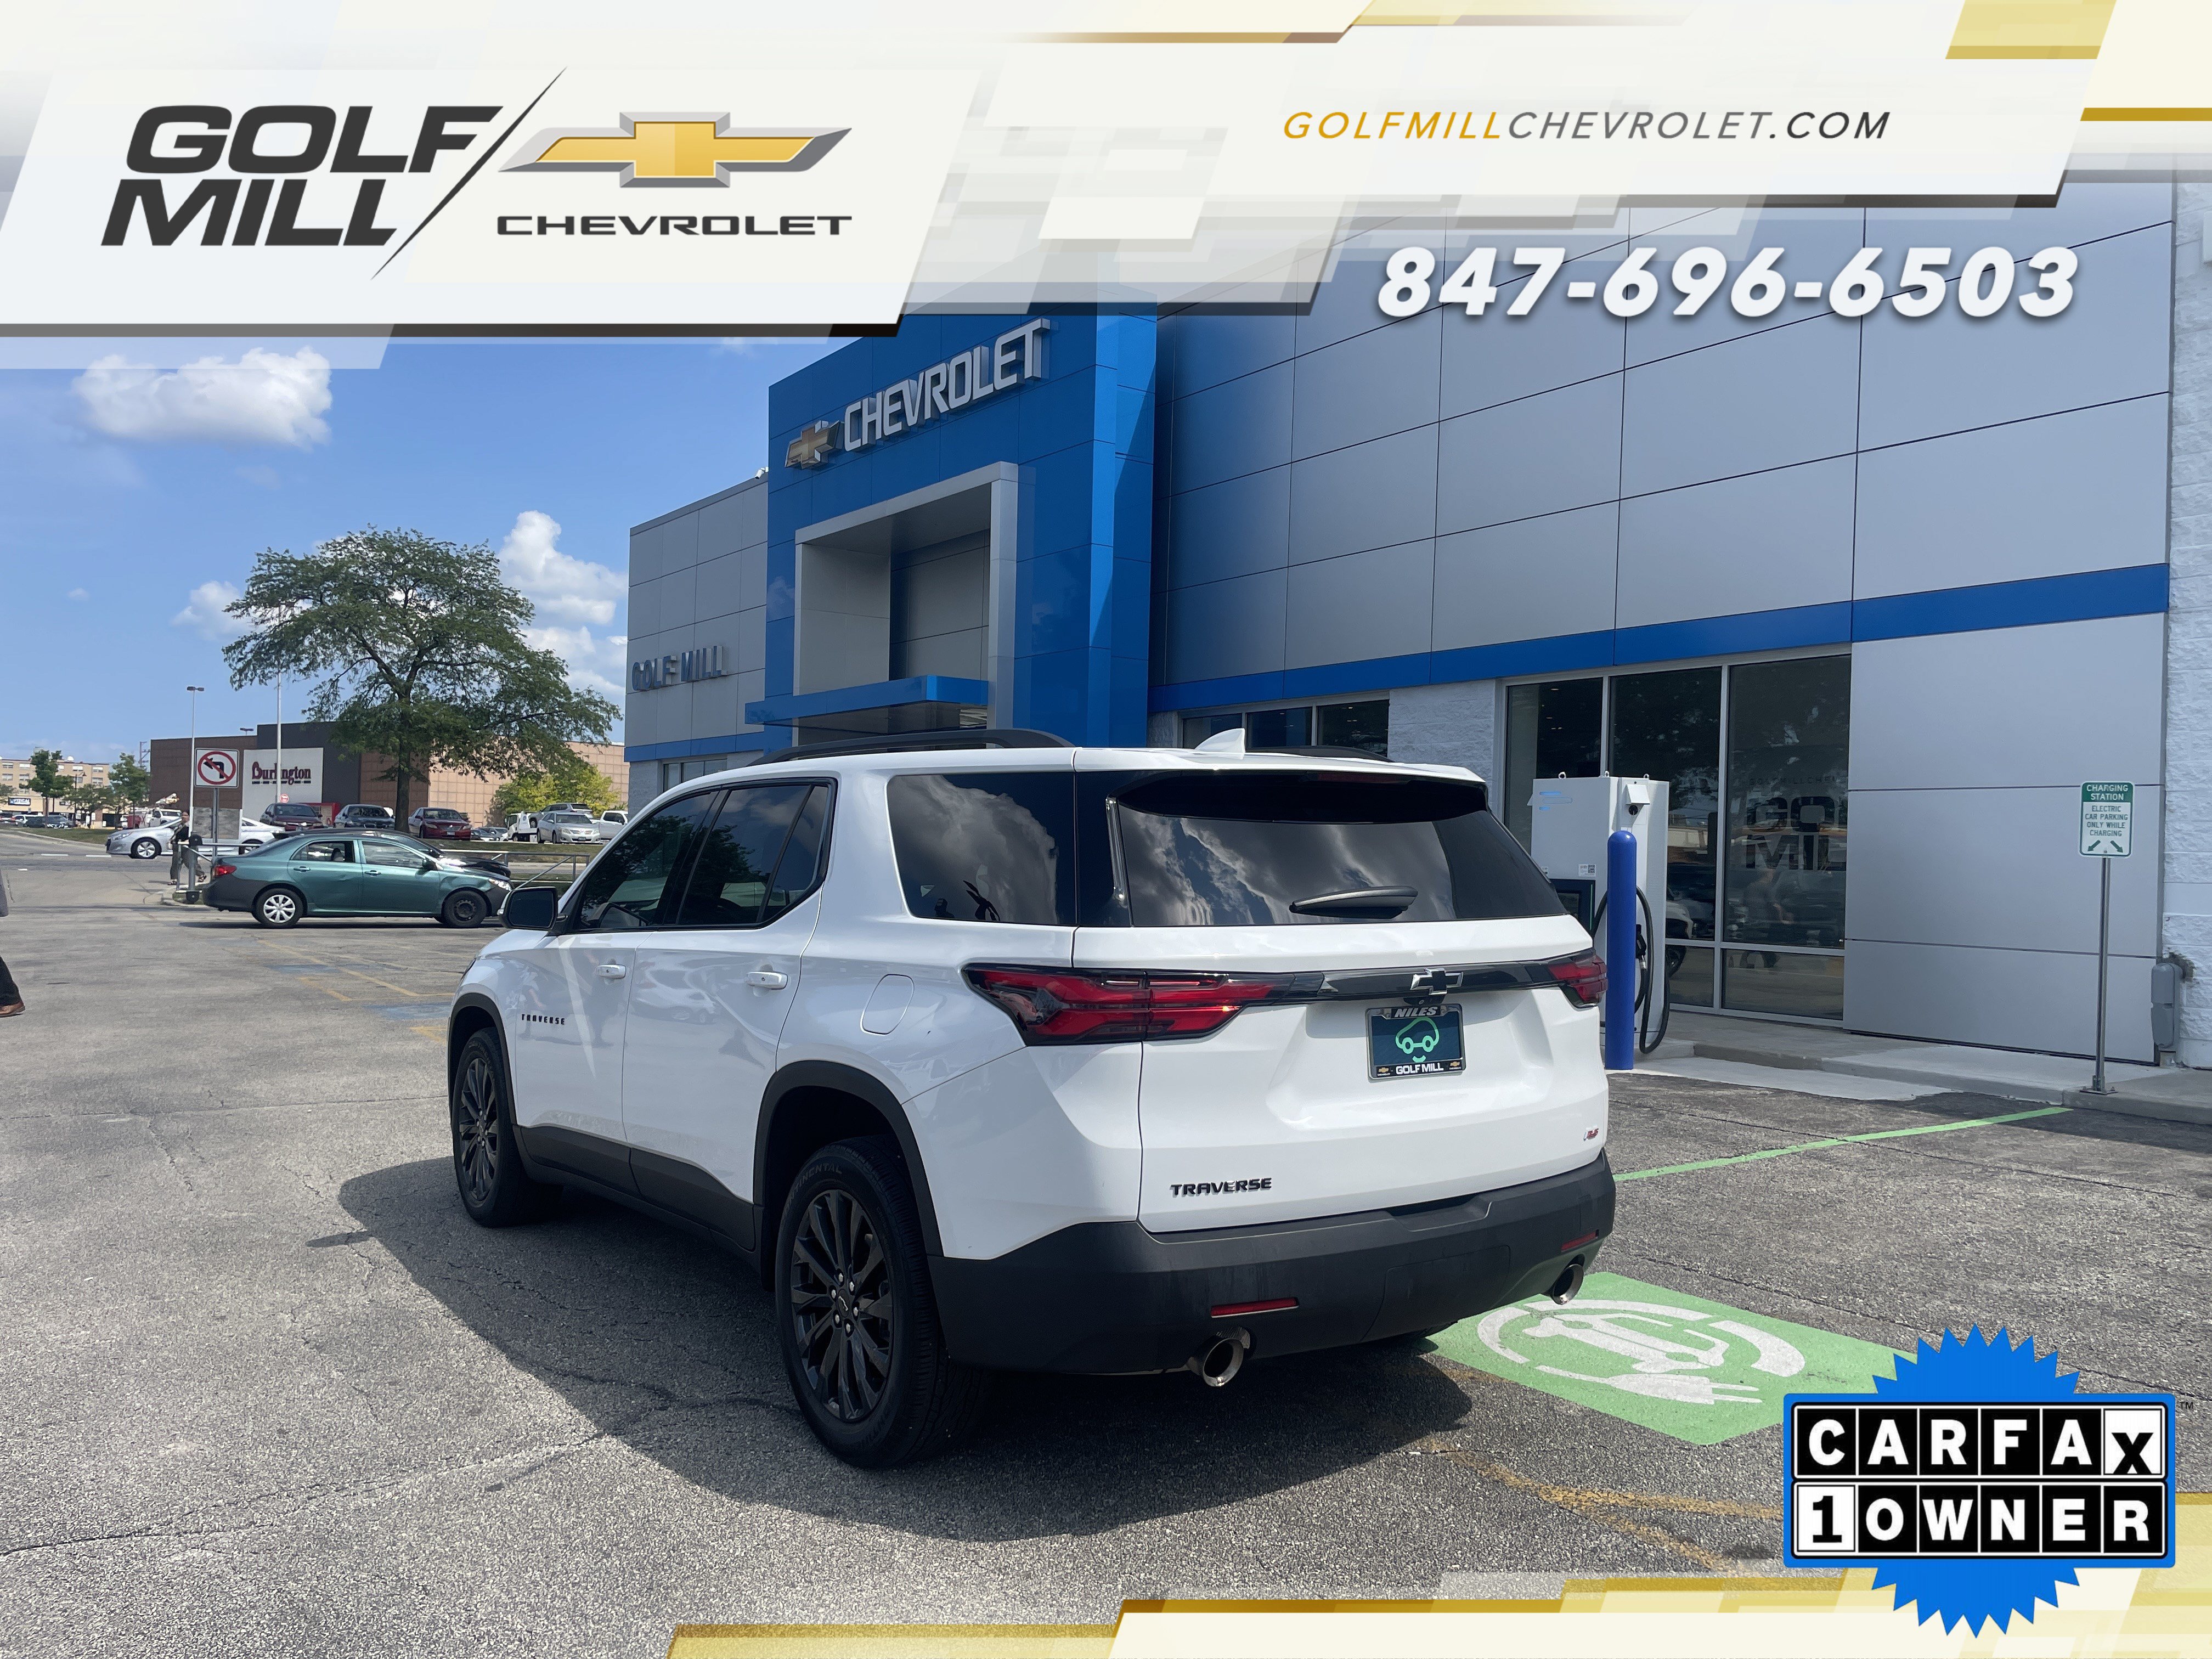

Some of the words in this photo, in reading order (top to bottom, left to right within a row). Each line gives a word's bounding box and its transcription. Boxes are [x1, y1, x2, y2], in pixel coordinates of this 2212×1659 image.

[844, 318, 1051, 452] CHEVROLET
[631, 655, 676, 691] GOLF
[681, 645, 727, 682] MILL
[252, 761, 312, 785] Burlngton
[522, 1014, 565, 1025] TRAVERSE
[1393, 1006, 1438, 1018] NILES
[1396, 1064, 1421, 1075] GOLF
[1421, 1062, 1444, 1073] MILL
[1170, 1177, 1272, 1196] TRAVERSE
